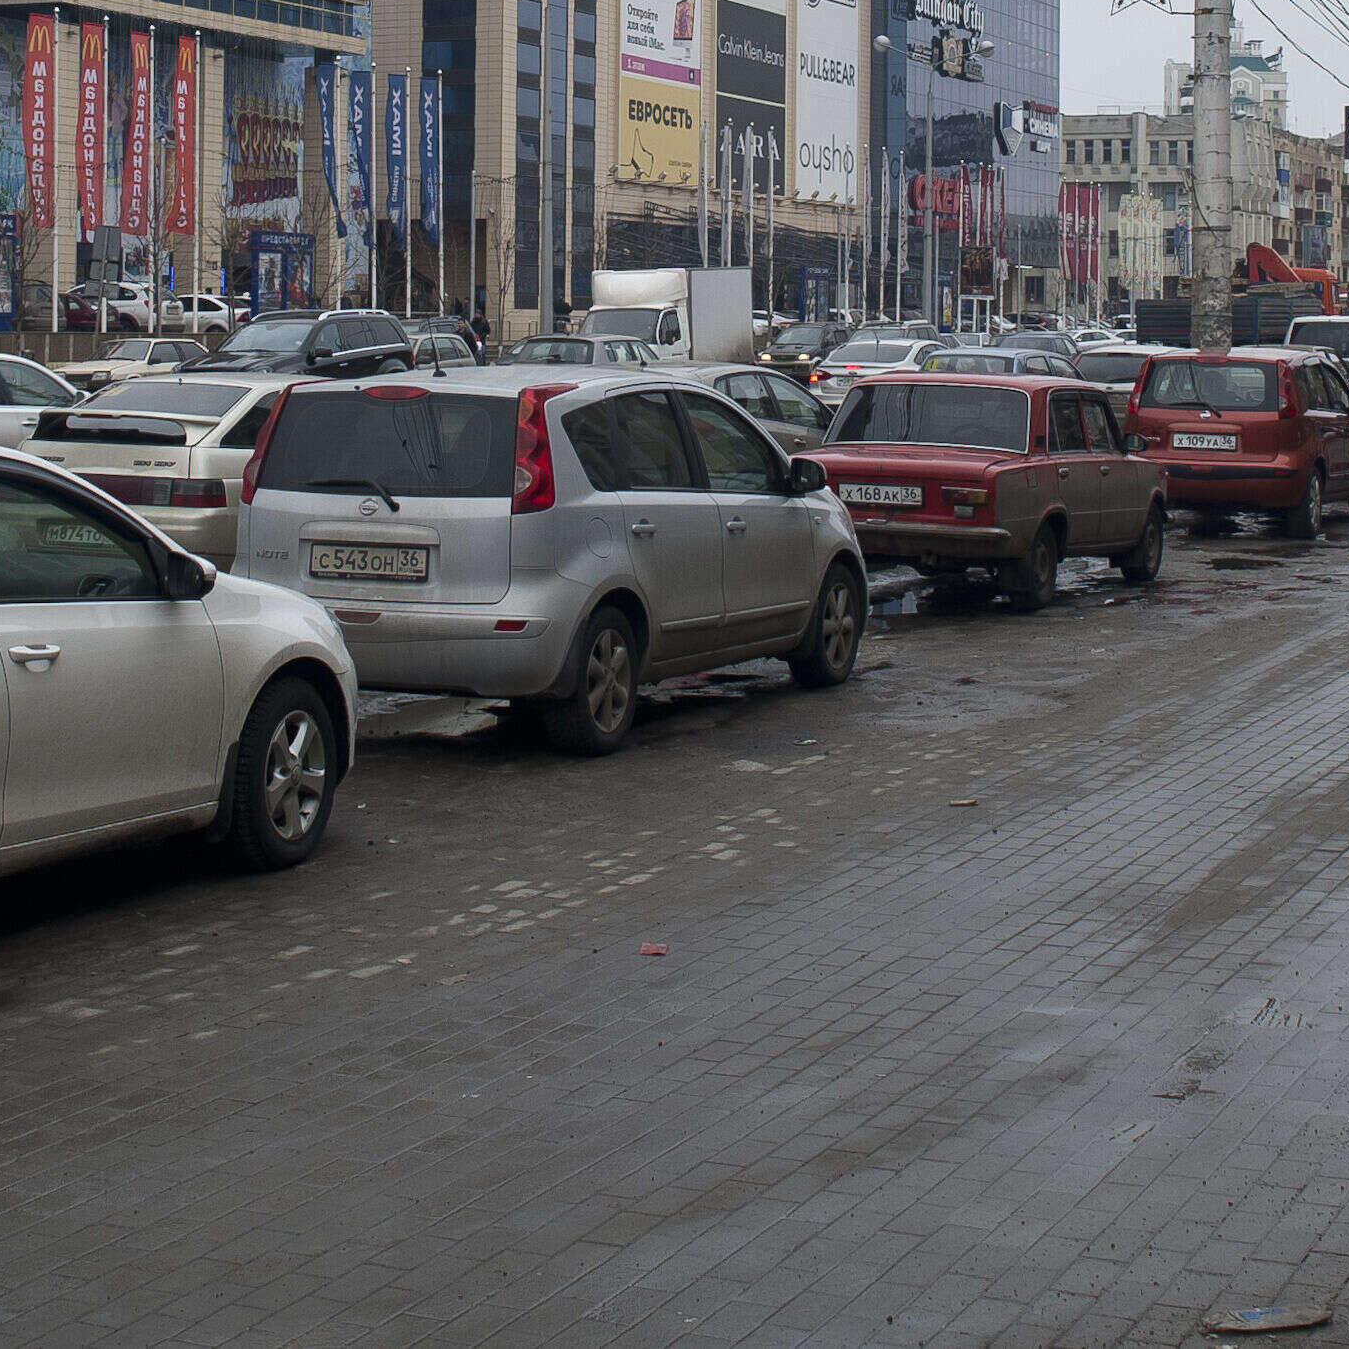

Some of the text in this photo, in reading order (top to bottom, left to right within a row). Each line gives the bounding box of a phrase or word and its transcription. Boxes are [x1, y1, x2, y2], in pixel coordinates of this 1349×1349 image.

[627, 3, 658, 22] Откройте
[963, 0, 985, 38] City
[640, 23, 655, 34] себя
[800, 52, 856, 87] PULL&BEAR
[629, 99, 693, 130] ЕВРОСЕТЬ
[799, 134, 854, 184] oysho
[904, 488, 917, 499] 36
[400, 551, 419, 567] 36
